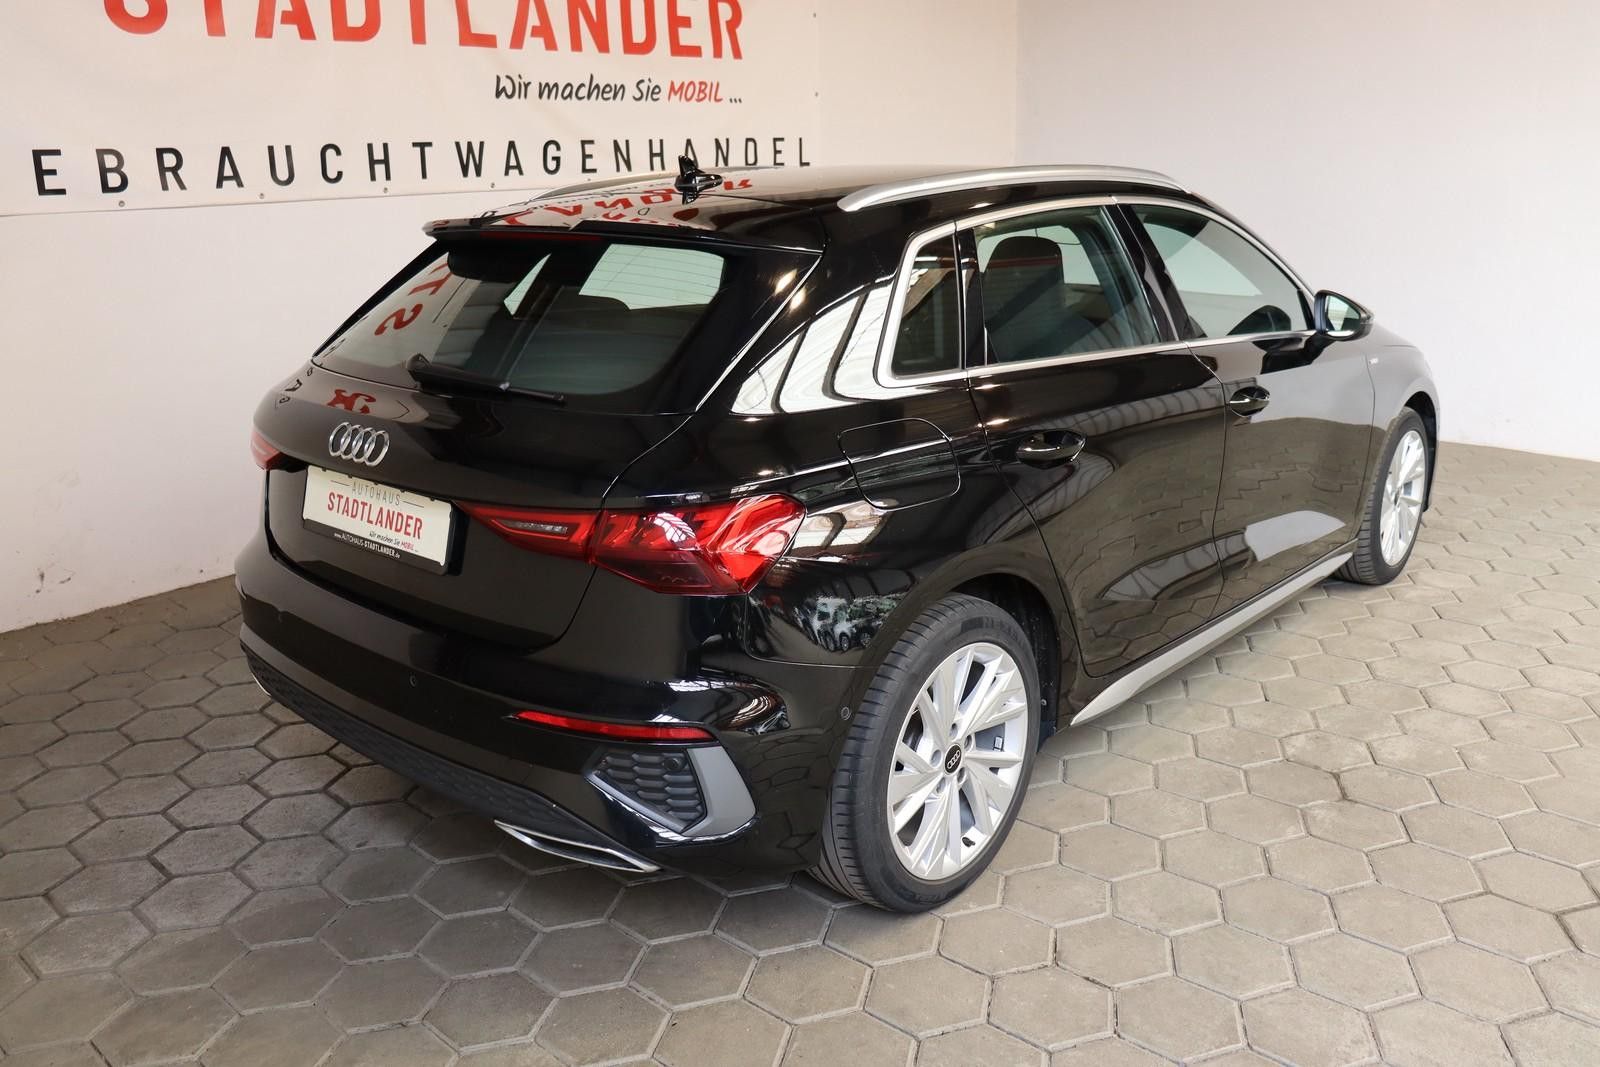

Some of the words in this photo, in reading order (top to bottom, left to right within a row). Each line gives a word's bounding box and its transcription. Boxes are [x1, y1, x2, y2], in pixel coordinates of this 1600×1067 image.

[494, 74, 532, 100] Wir
[538, 73, 626, 101] machen
[632, 78, 662, 102] Sie
[667, 80, 723, 103] MOBIL
[352, 481, 400, 506] AUTOHAUS
[327, 491, 423, 540] STADTLANDER
